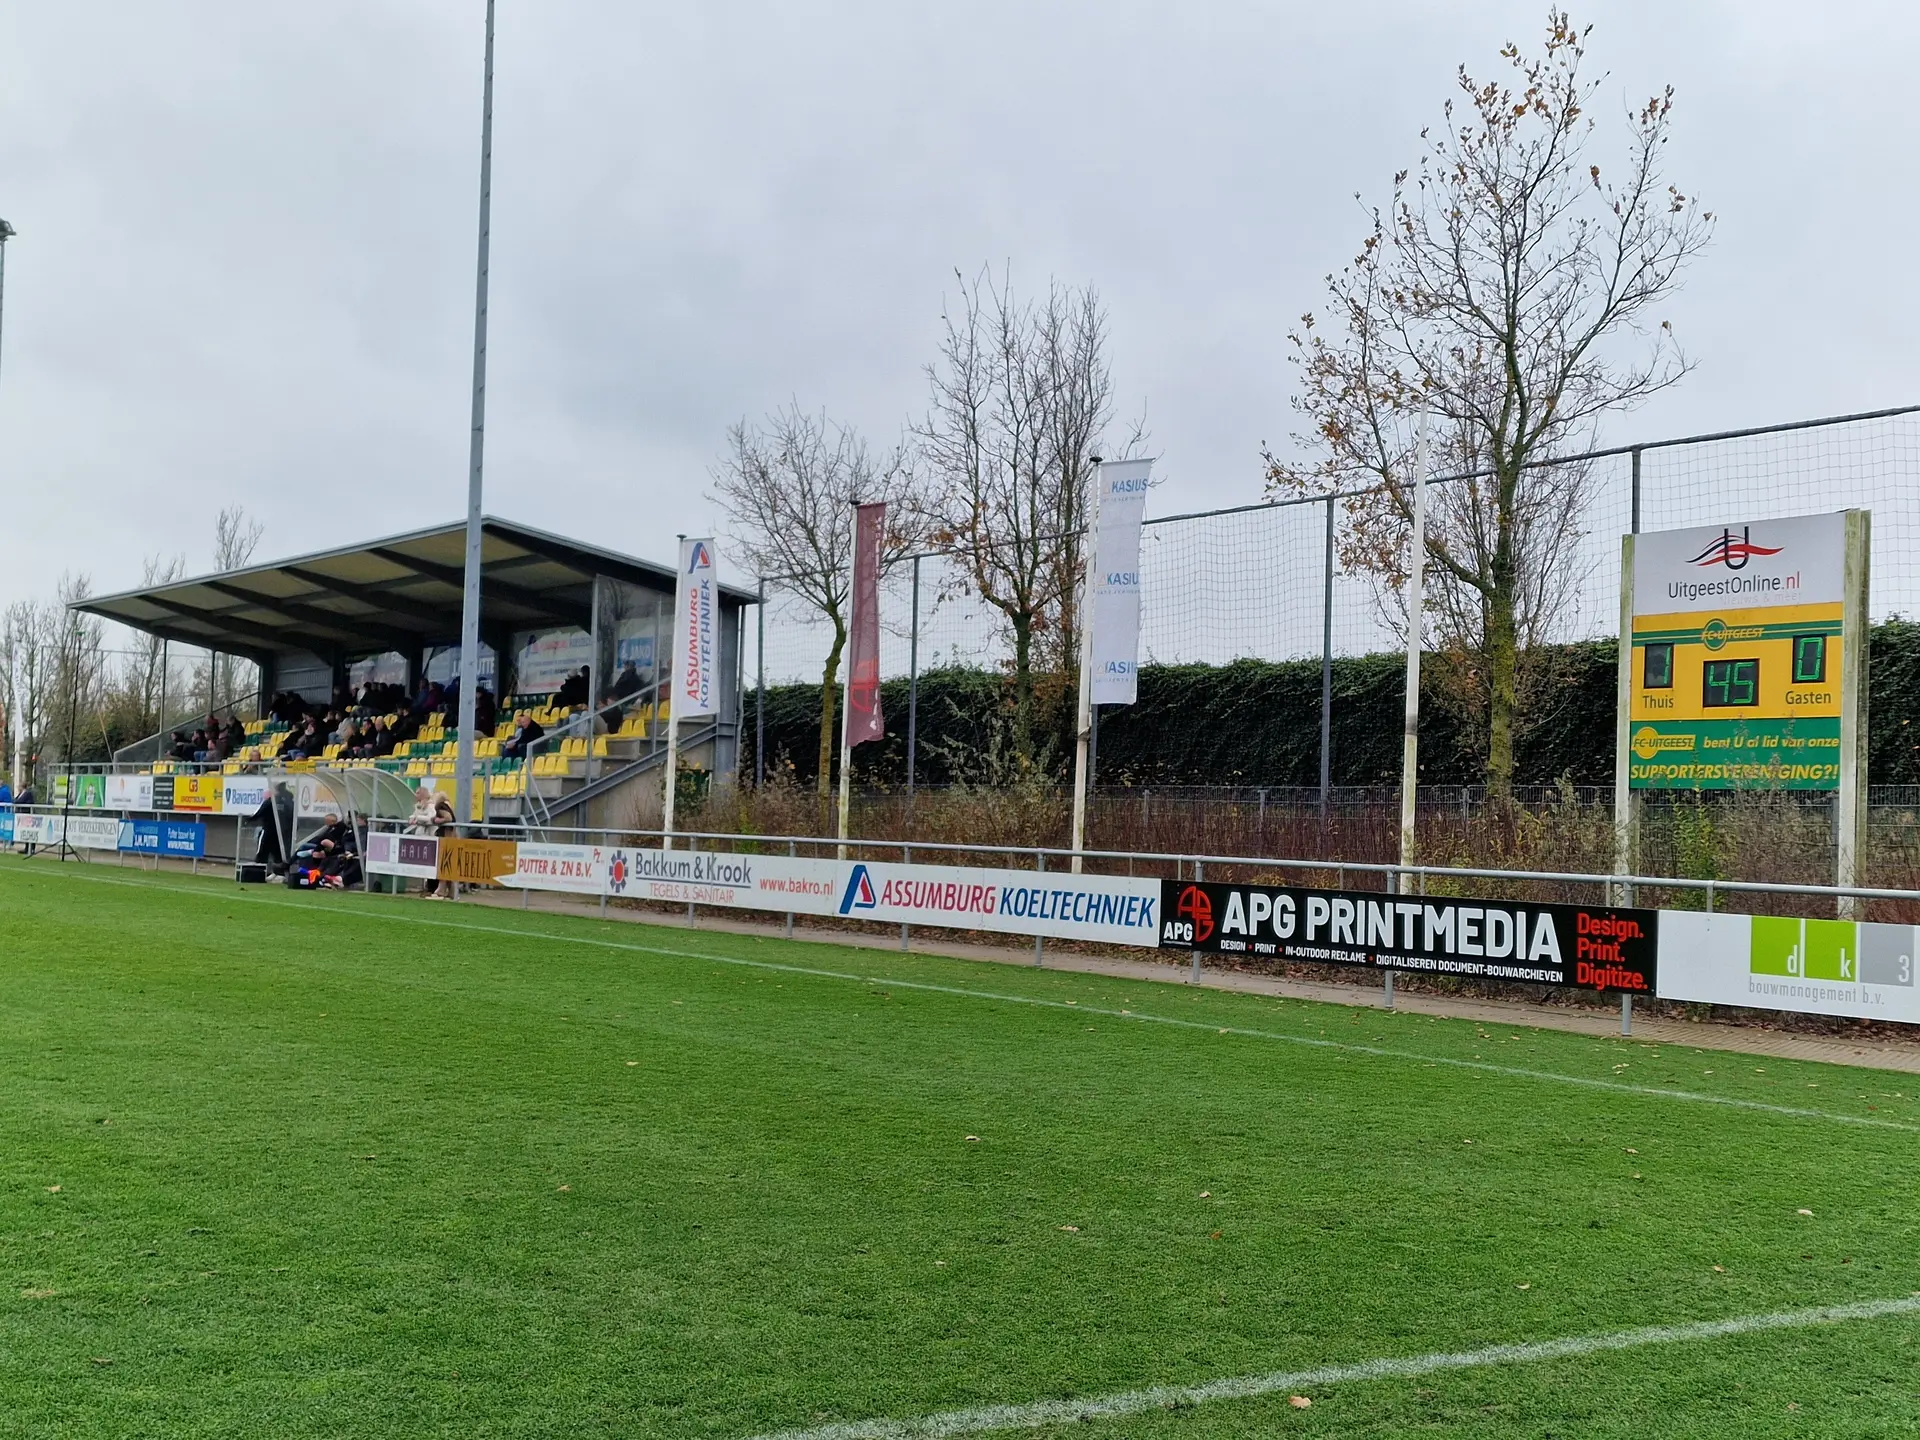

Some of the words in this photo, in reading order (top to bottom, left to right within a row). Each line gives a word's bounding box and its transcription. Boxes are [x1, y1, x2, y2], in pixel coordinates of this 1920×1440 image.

[1111, 478, 1148, 493] KASIUS
[1107, 572, 1139, 586] KASIU
[1668, 571, 1800, 601] UitgeestOnline.nl
[686, 588, 699, 700] ASSUMBURG
[700, 578, 711, 708] KOELTECHNIEK
[1663, 647, 1671, 685] 1
[1796, 637, 1823, 681] 0
[1709, 661, 1755, 704] 45
[1643, 694, 1674, 708] Thuis
[1785, 691, 1832, 705] Gasten
[1734, 735, 1744, 748] U
[1762, 735, 1779, 747] lid
[1782, 737, 1805, 747] van
[1807, 737, 1840, 747] onze
[1631, 764, 1840, 780] SUPPORTERSVERENGING?!
[457, 847, 492, 879] KRELIS
[518, 858, 548, 875] PUTTER
[551, 860, 557, 875] &
[560, 861, 574, 876] ZN
[576, 862, 592, 878] B.V.
[635, 852, 691, 879] Bakkum
[693, 855, 704, 879] &
[706, 852, 752, 883] Krook
[649, 883, 680, 898] TEGELS
[683, 885, 690, 899] &
[692, 886, 735, 904] SANITAIR
[760, 876, 834, 895] www.bakro.nl
[880, 879, 996, 914] ASSUMBURG
[999, 887, 1156, 928] KOELTECHNIEK
[1163, 921, 1193, 941] APG
[1221, 891, 1296, 939] APG
[1306, 896, 1563, 963] PRINTMEDIA
[1577, 912, 1645, 942] Design.
[1220, 939, 1246, 951] DESIGN
[1255, 944, 1276, 954] PRINT
[1285, 946, 1330, 960] IN-OUTDOOR
[1331, 950, 1366, 963] RECLAME
[1376, 954, 1437, 970] DIGITALISEREN
[1438, 961, 1563, 983] DOCUMENT-BOUWARCHIEVEN
[1577, 937, 1626, 962] Print.
[1786, 944, 1798, 974] d
[1839, 947, 1851, 978] k
[1898, 954, 1910, 983] 3
[1577, 962, 1649, 991] Digitize.
[1749, 976, 1857, 1003] bouwmanagement
[1862, 985, 1885, 1005] b.v.
